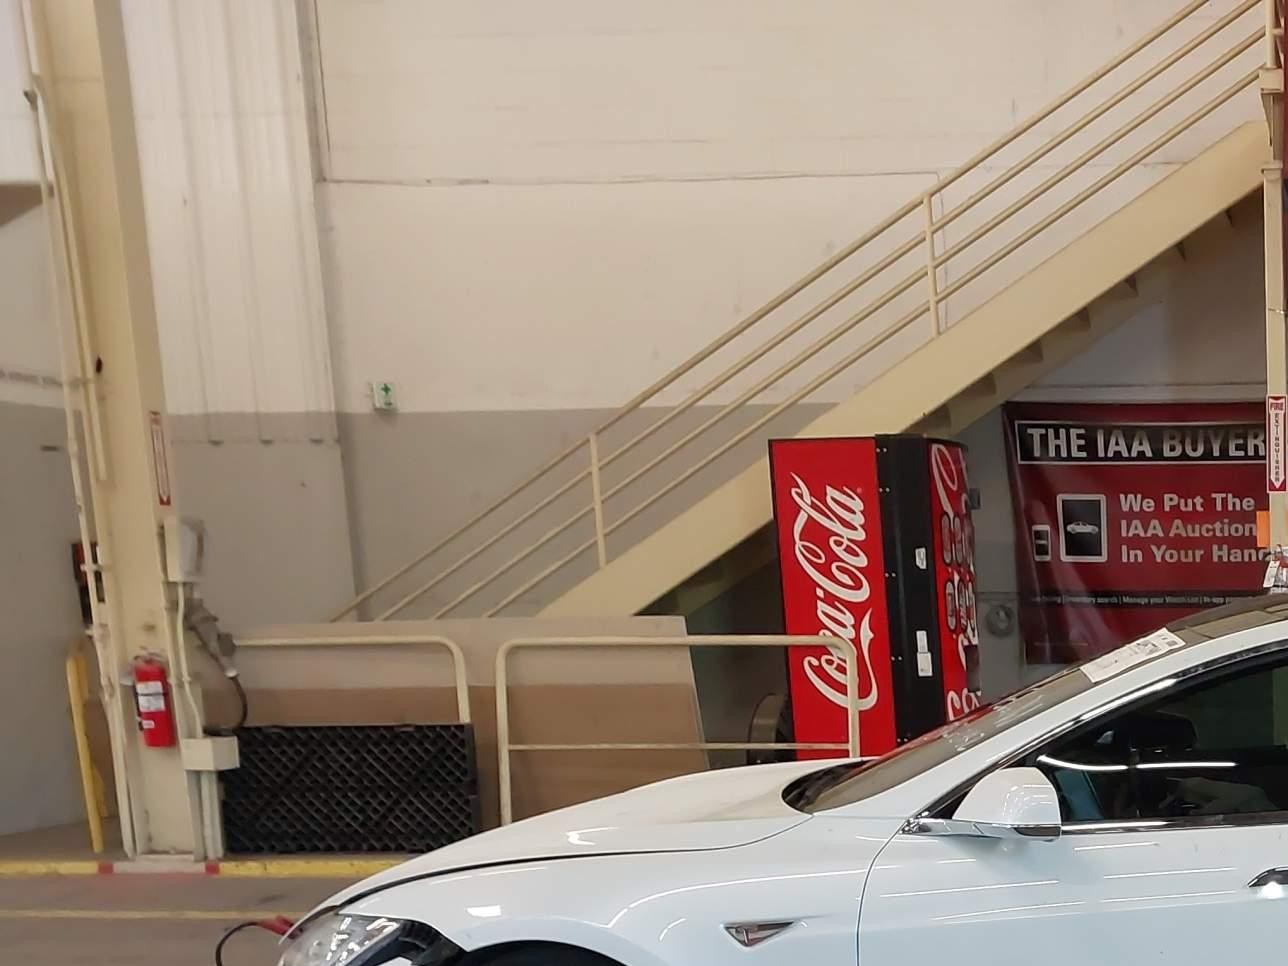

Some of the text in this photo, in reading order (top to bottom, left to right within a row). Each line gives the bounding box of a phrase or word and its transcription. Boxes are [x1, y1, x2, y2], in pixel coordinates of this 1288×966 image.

[1027, 427, 1087, 458] THE
[1097, 427, 1153, 458] IAA
[1163, 427, 1266, 458] BUYER
[1119, 492, 1255, 512] We Put The
[1120, 519, 1164, 537] IAA
[1168, 518, 1257, 537] Auction
[1121, 544, 1266, 563] In Your Han
